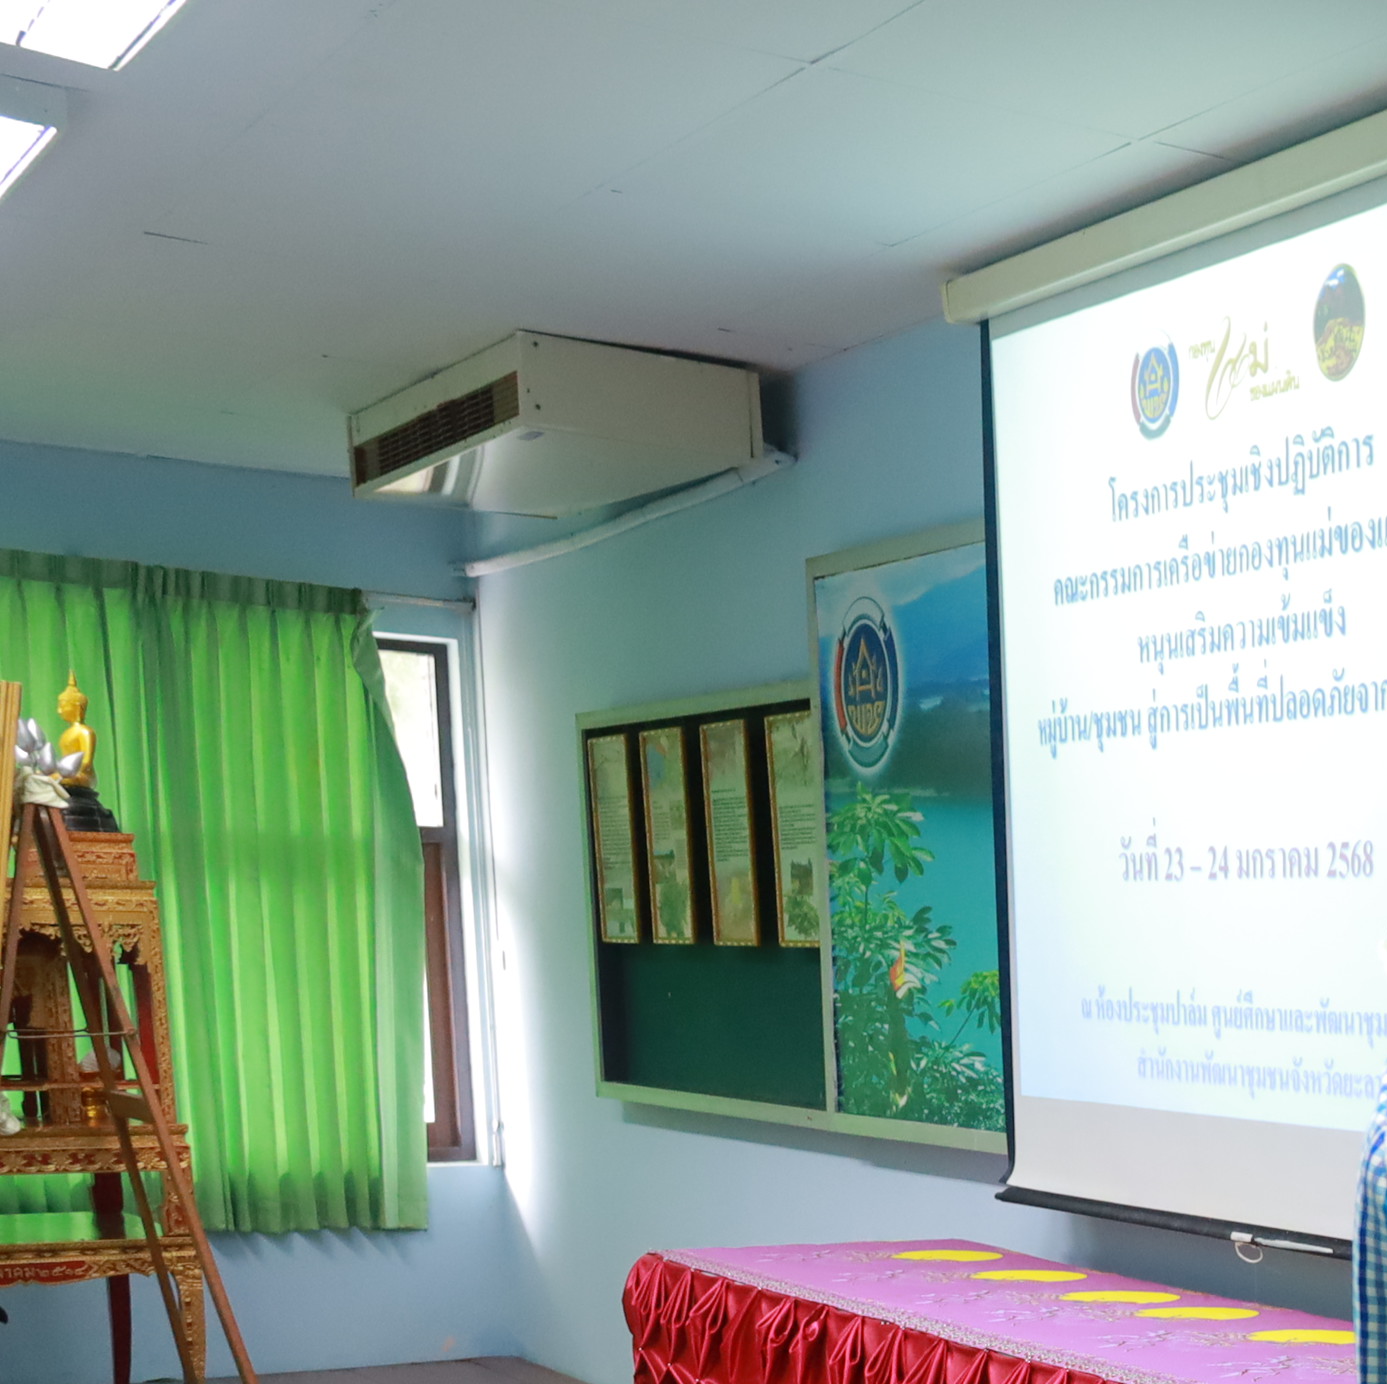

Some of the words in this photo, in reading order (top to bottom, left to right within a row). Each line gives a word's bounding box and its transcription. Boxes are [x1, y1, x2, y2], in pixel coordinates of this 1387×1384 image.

[1108, 427, 1376, 522] โครงการประชุมเชิงปฏิบัติการ
[1137, 588, 1347, 676] หนุนเสริมความเข้มแข็ง
[1037, 697, 1142, 759] หมู่บ้าน/ชุมชน
[1119, 817, 1159, 883] วันที่
[1164, 846, 1184, 882] 23
[1208, 845, 1229, 880] 24
[1236, 846, 1319, 880] มกราคม
[1326, 840, 1374, 879] 2568
[1081, 995, 1093, 1020] ณ
[1095, 984, 1208, 1035] ห้องประชุมปาล์ม
